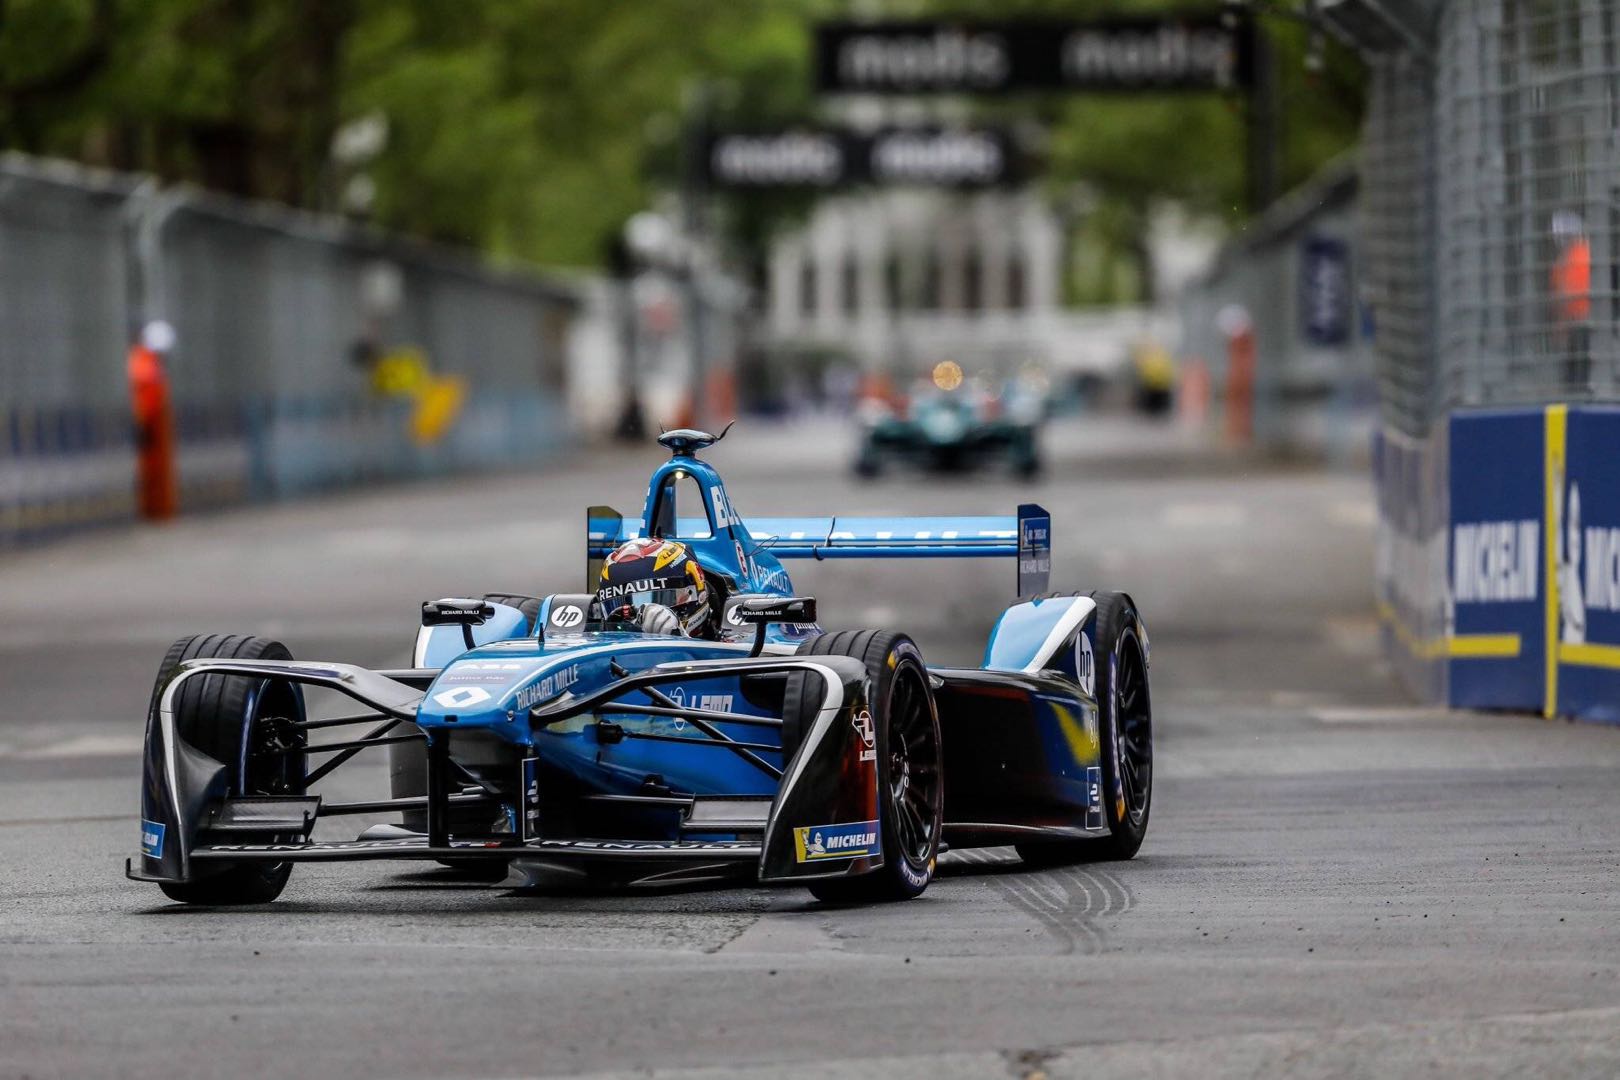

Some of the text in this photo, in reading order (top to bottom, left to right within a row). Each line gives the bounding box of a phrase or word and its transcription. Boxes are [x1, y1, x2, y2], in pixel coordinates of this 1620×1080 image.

[600, 578, 668, 601] RENAULT
[556, 605, 578, 628] hp
[516, 664, 579, 710] RICHARD MILLE
[826, 832, 876, 849] MICHELIN
